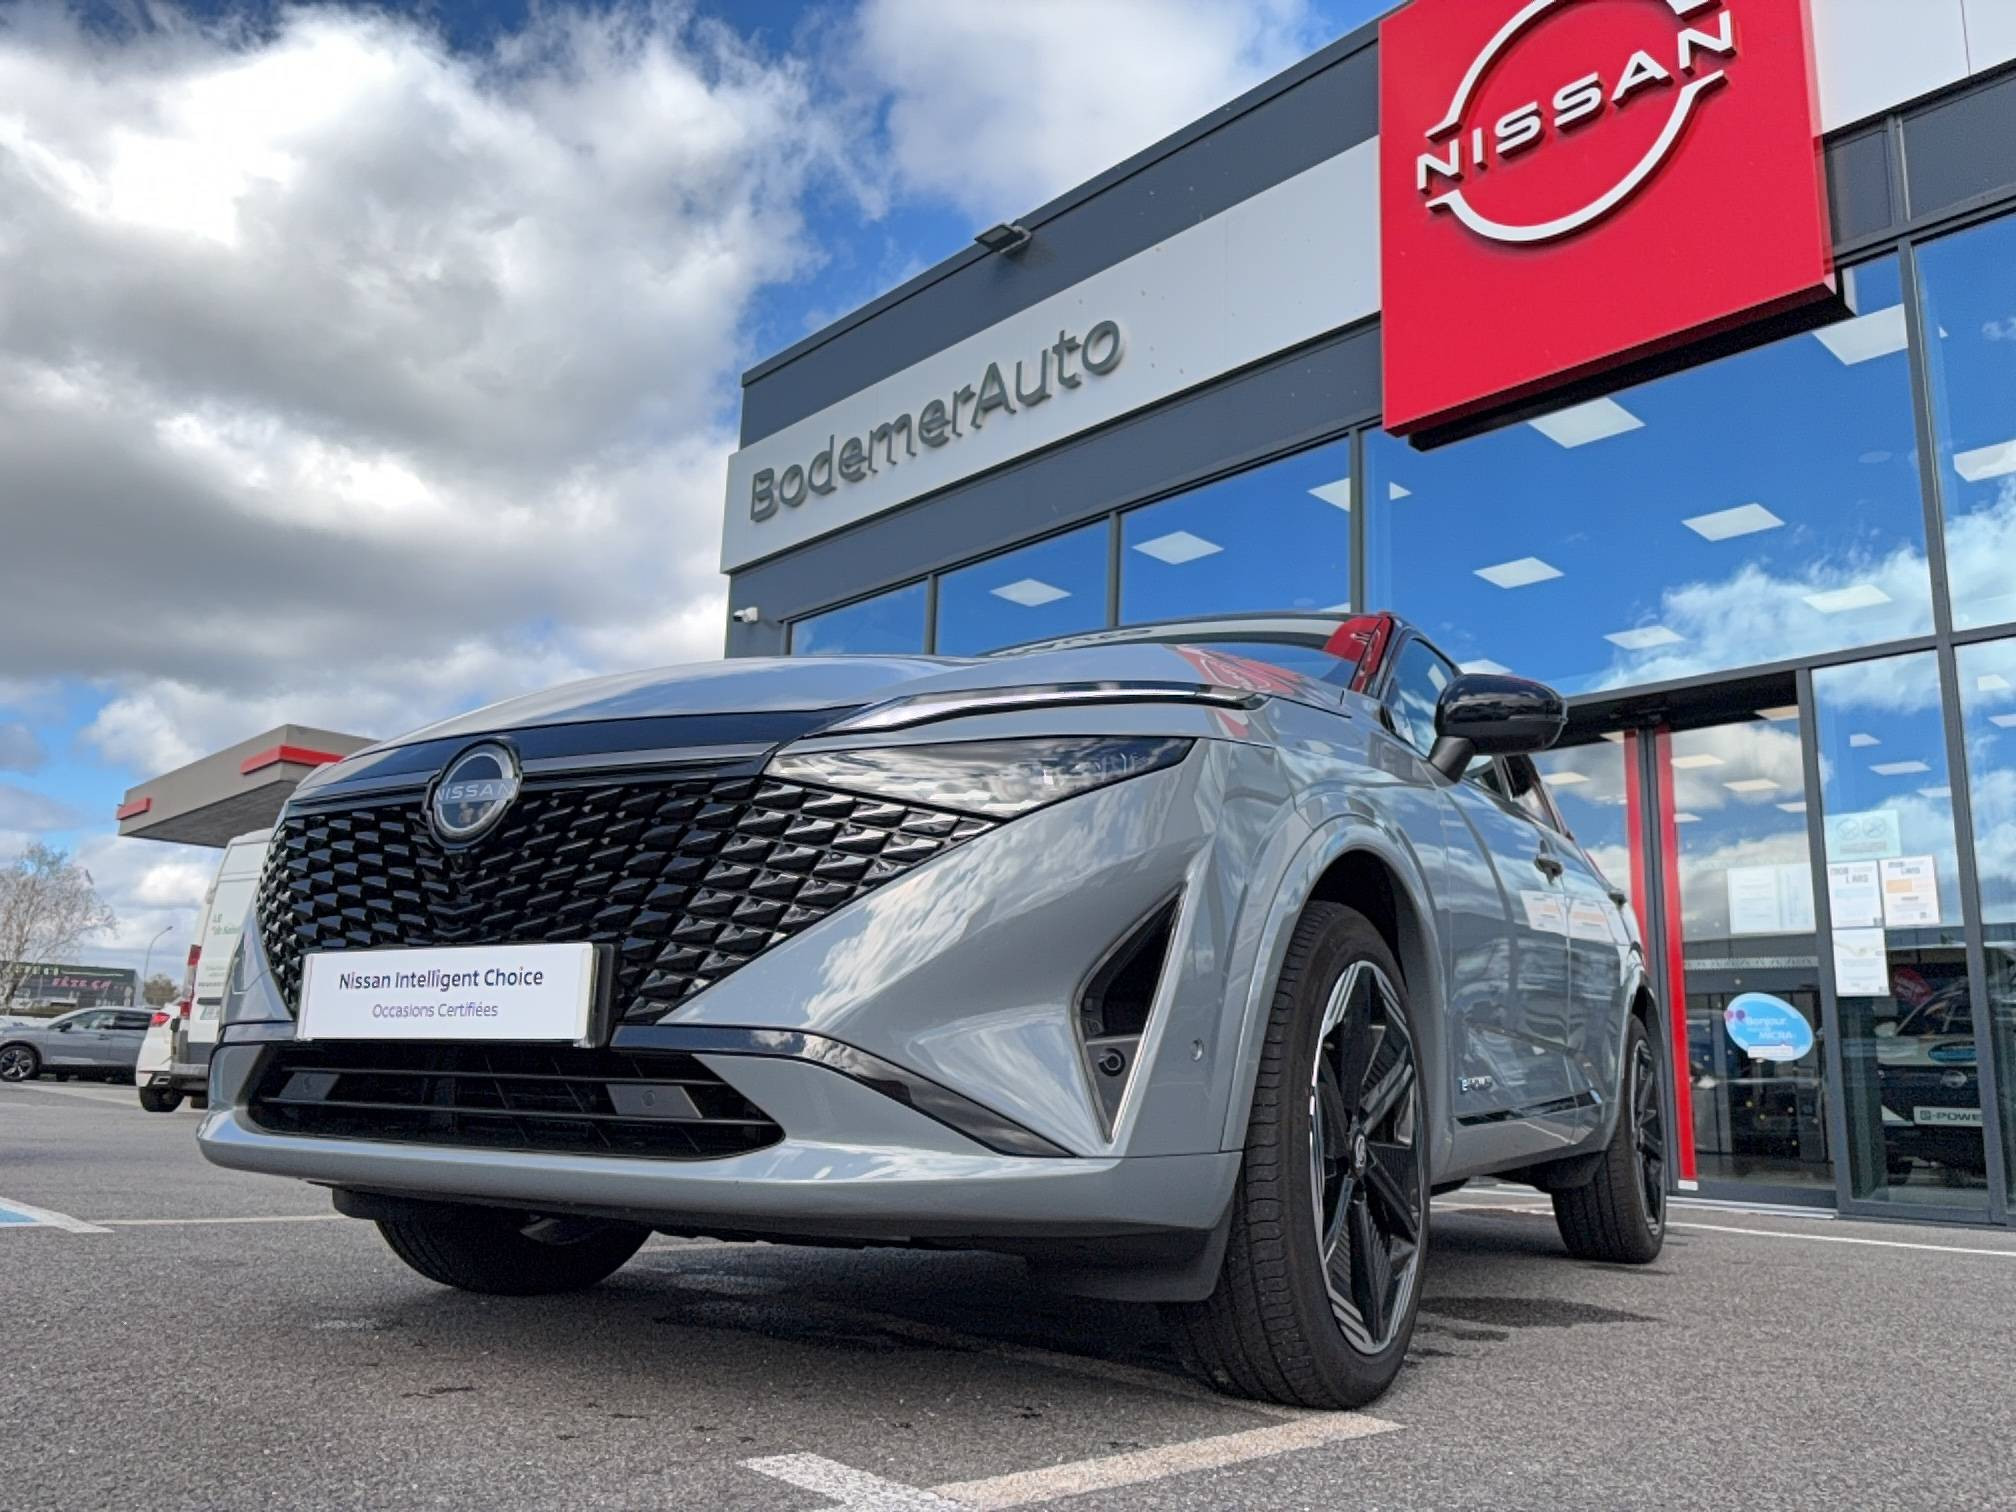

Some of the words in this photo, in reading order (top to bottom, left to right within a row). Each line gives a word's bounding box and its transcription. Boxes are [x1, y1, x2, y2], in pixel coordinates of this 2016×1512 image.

[1417, 9, 1735, 192] NISSAN
[750, 320, 1124, 523] BodemerAuto
[436, 780, 514, 801] NISSAN
[339, 972, 391, 990] Nissan
[395, 969, 480, 993] Intelligent
[484, 966, 544, 987] Choice
[372, 1003, 435, 1018] Occasions
[438, 1001, 499, 1018] Certifiées
